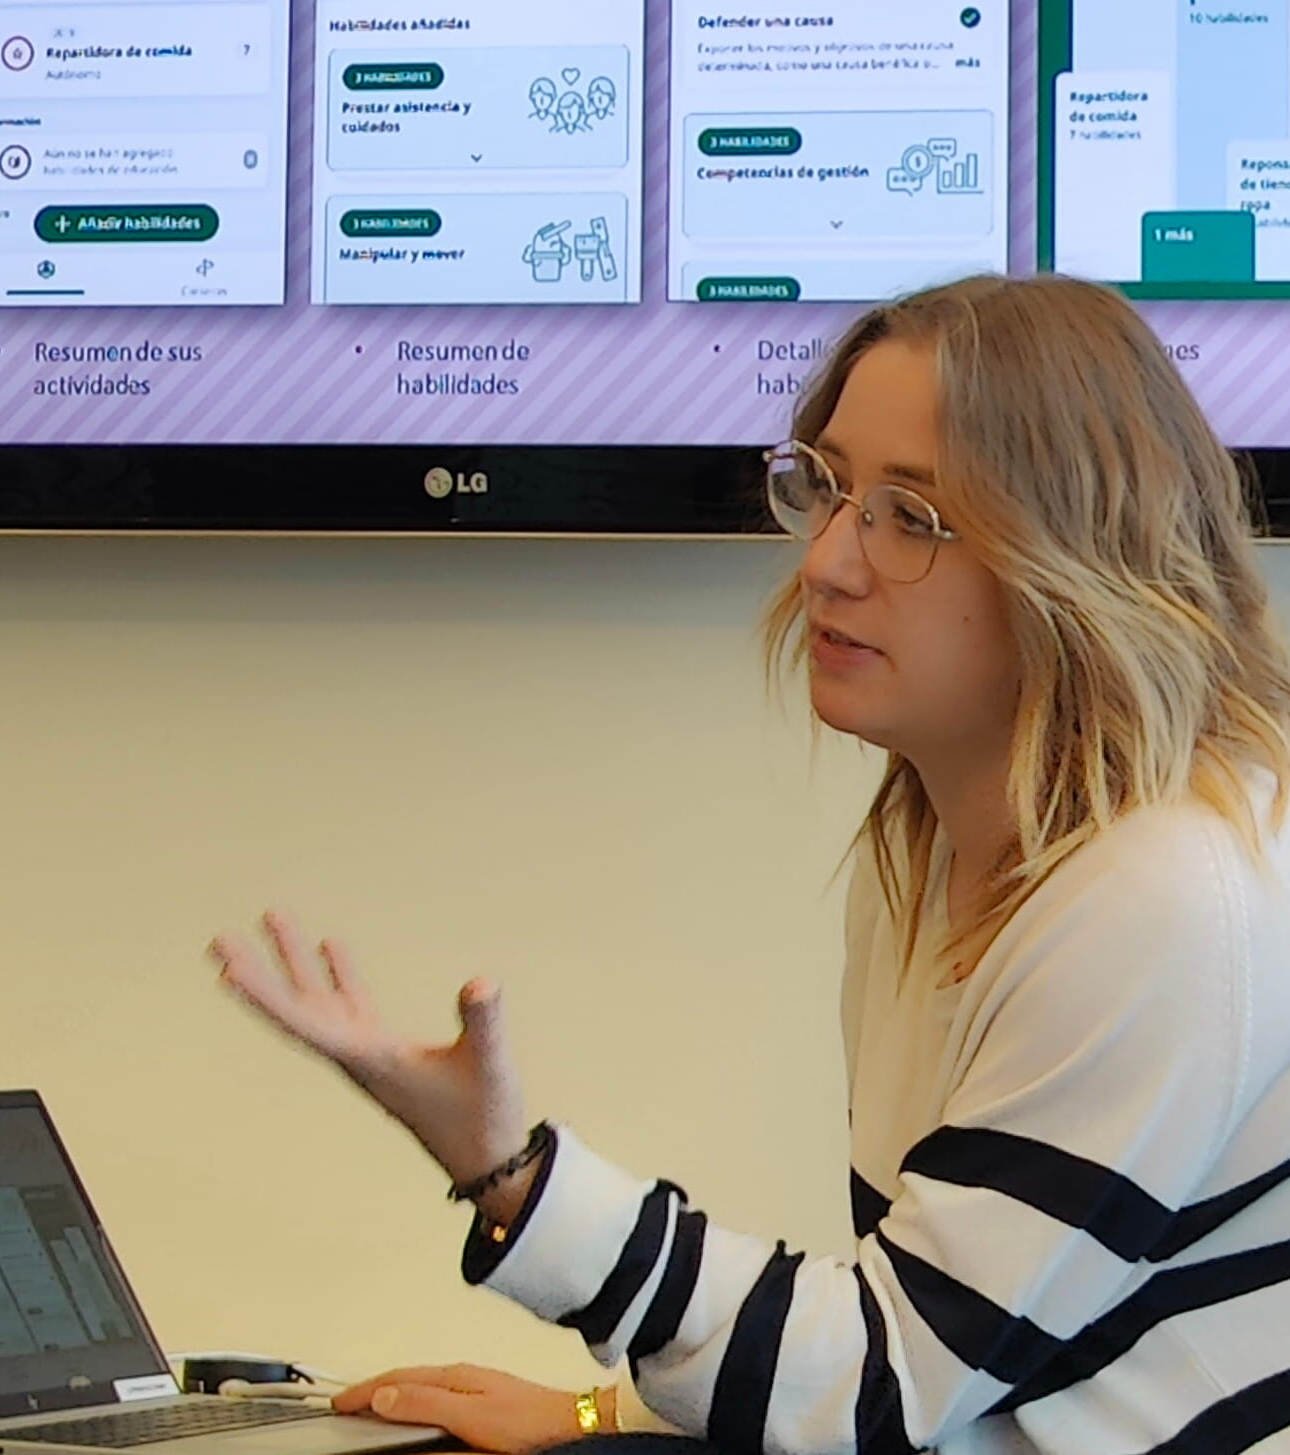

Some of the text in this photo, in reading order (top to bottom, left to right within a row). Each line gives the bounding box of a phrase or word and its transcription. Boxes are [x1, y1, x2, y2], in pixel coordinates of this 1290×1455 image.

[698, 16, 834, 29] Defender una causa
[126, 46, 142, 58] de
[342, 100, 390, 114] Prestar
[462, 102, 471, 116] y
[1069, 111, 1086, 123] de
[342, 121, 400, 134] cuidados
[797, 166, 814, 179] de
[1240, 179, 1257, 190] de
[77, 215, 201, 230] Añadir habilidades
[1165, 226, 1194, 241] más
[410, 250, 418, 264] y
[422, 249, 465, 260] mover
[35, 341, 203, 363] Resumen de sus
[397, 339, 530, 361] Resumen de
[33, 375, 150, 397] actividades
[397, 373, 519, 395] habilidades
[457, 472, 488, 494] LG
